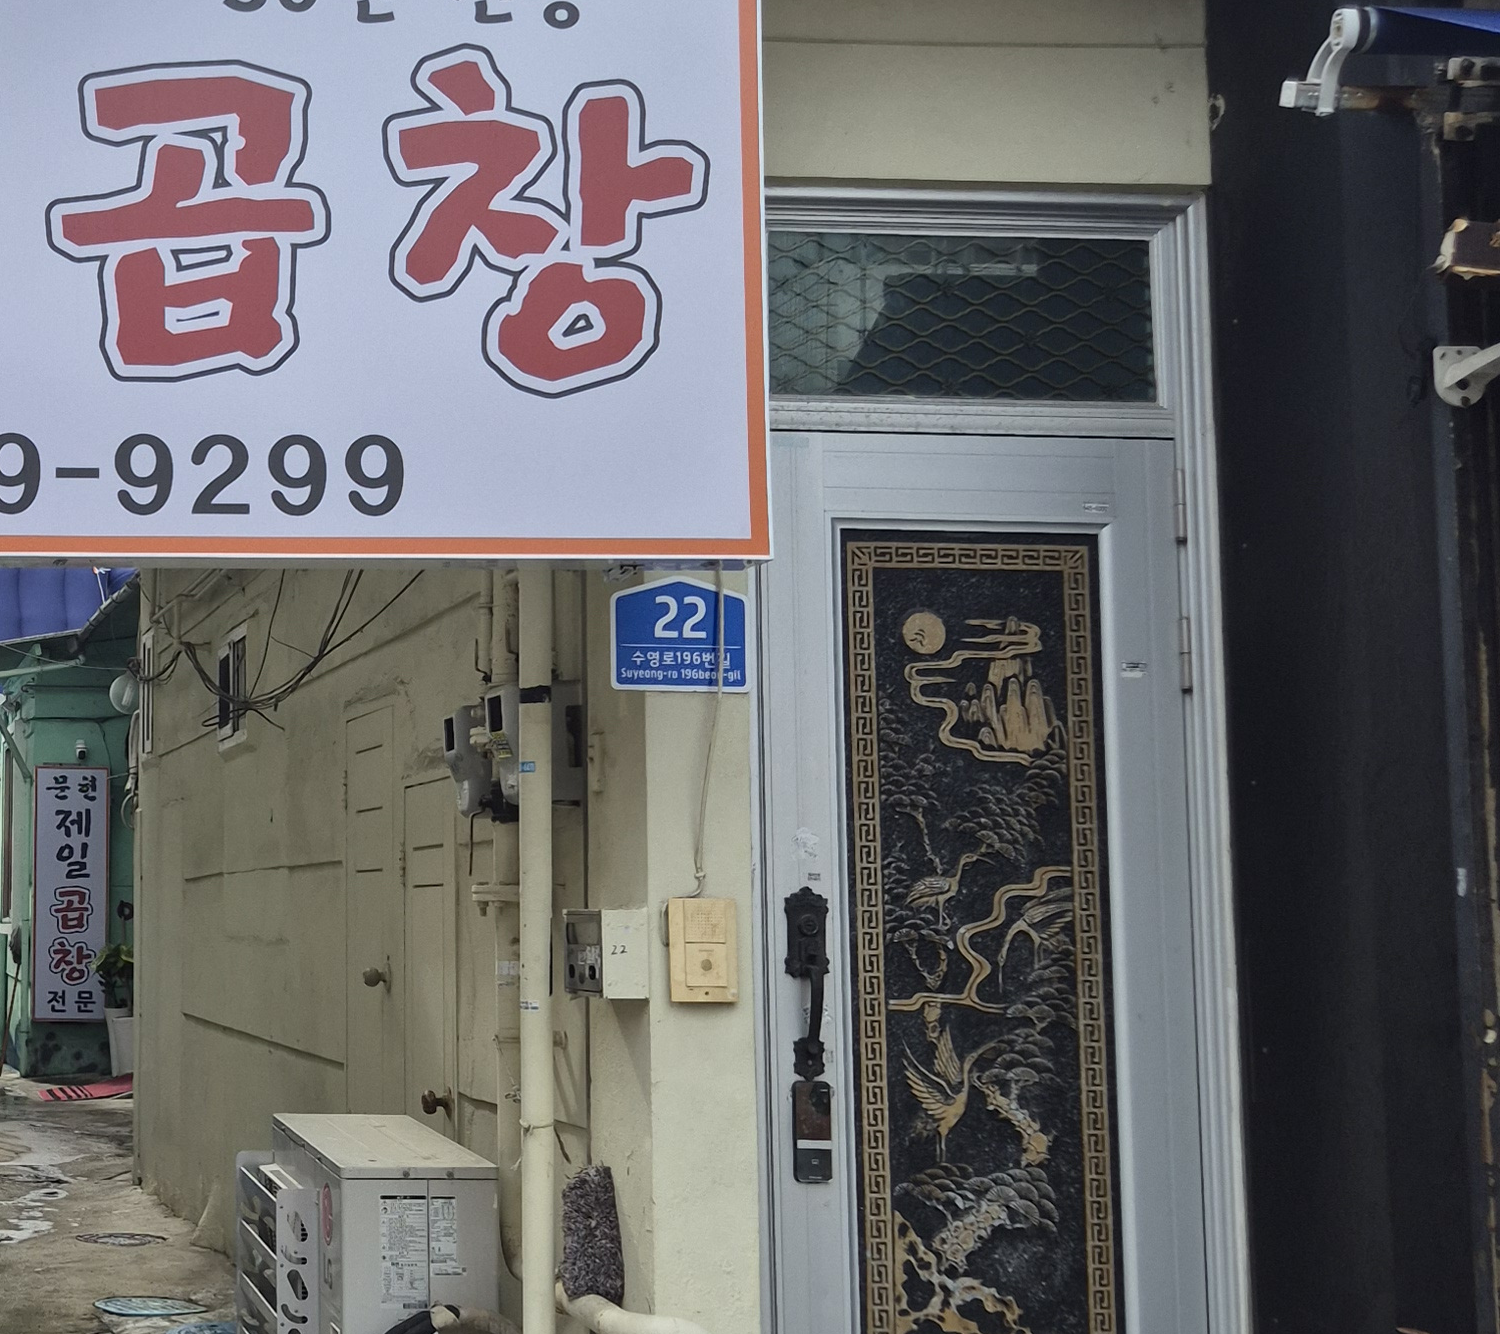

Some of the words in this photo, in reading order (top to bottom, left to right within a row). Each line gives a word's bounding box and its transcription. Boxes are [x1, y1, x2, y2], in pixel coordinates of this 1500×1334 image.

[654, 595, 708, 639] 22
[621, 667, 679, 681] Suyeong-ro
[681, 668, 741, 682] 196beo-gil
[46, 774, 98, 802] 문현
[610, 944, 628, 956] 22
[47, 989, 97, 1014] 전문
